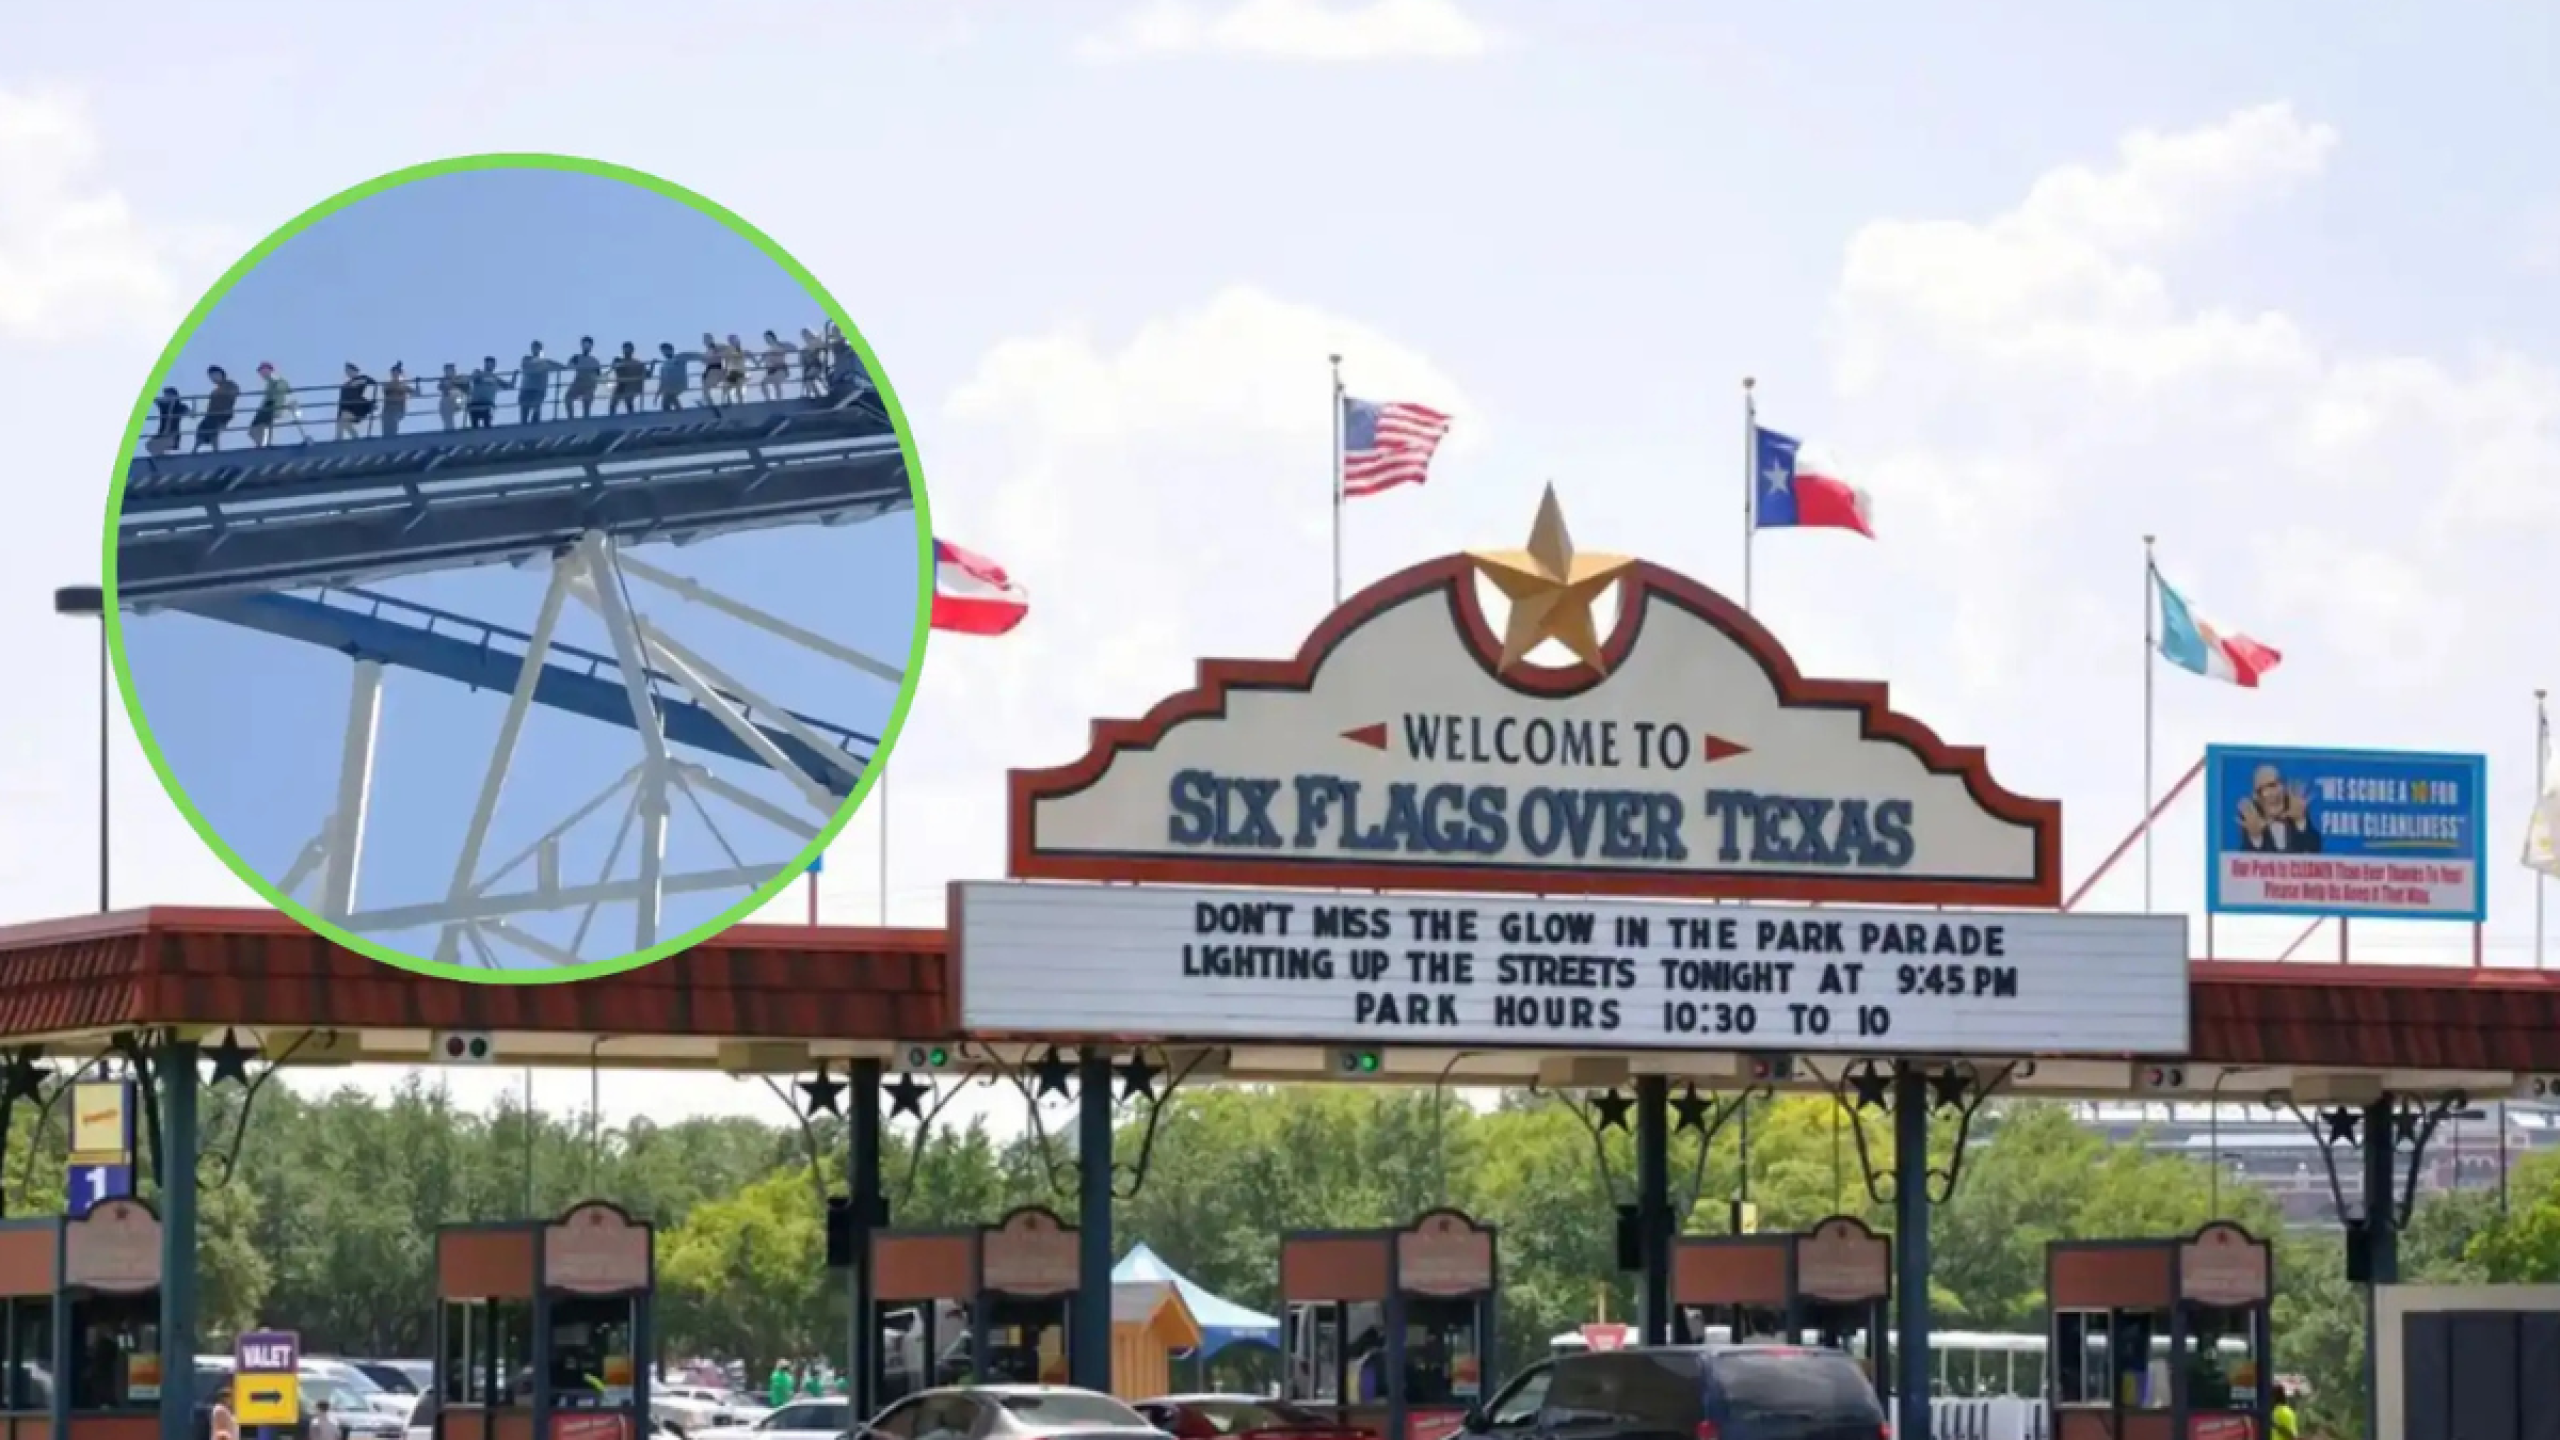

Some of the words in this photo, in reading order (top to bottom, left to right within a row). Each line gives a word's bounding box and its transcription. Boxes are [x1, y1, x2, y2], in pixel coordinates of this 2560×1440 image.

[1403, 713, 1619, 768] WELCOME
[1634, 722, 1690, 770] TO
[1168, 768, 1284, 848] SIX
[1293, 774, 1509, 856] FLAGS
[1518, 785, 1689, 862] OVER
[1705, 788, 1915, 868] TEXAS
[1195, 902, 1294, 936] DON'T
[1313, 905, 1392, 939] MISS
[1408, 908, 1479, 942] THE
[1499, 911, 1595, 945] GLOW
[1615, 916, 1648, 948] IN
[1667, 918, 1738, 950] THE
[1757, 920, 1845, 953] PARK
[1860, 923, 2005, 957] PARADE
[1183, 944, 1335, 980] LIGHTING
[1351, 949, 1391, 982] UP
[1406, 951, 1475, 985] THE
[1497, 953, 1637, 989] STREETS
[1660, 958, 1795, 995] TONIGHT
[1817, 962, 1864, 995] AT
[1896, 963, 1966, 996] 9:45
[1973, 965, 2018, 998] PM
[1355, 992, 1459, 1027] PARK
[1495, 995, 1622, 1031] HOURS
[1663, 1000, 1757, 1035] 10:30
[1787, 1003, 1831, 1036] TO
[1858, 1004, 1891, 1037] 10
[84, 1167, 106, 1208] 1
[243, 1344, 293, 1368] VALET
